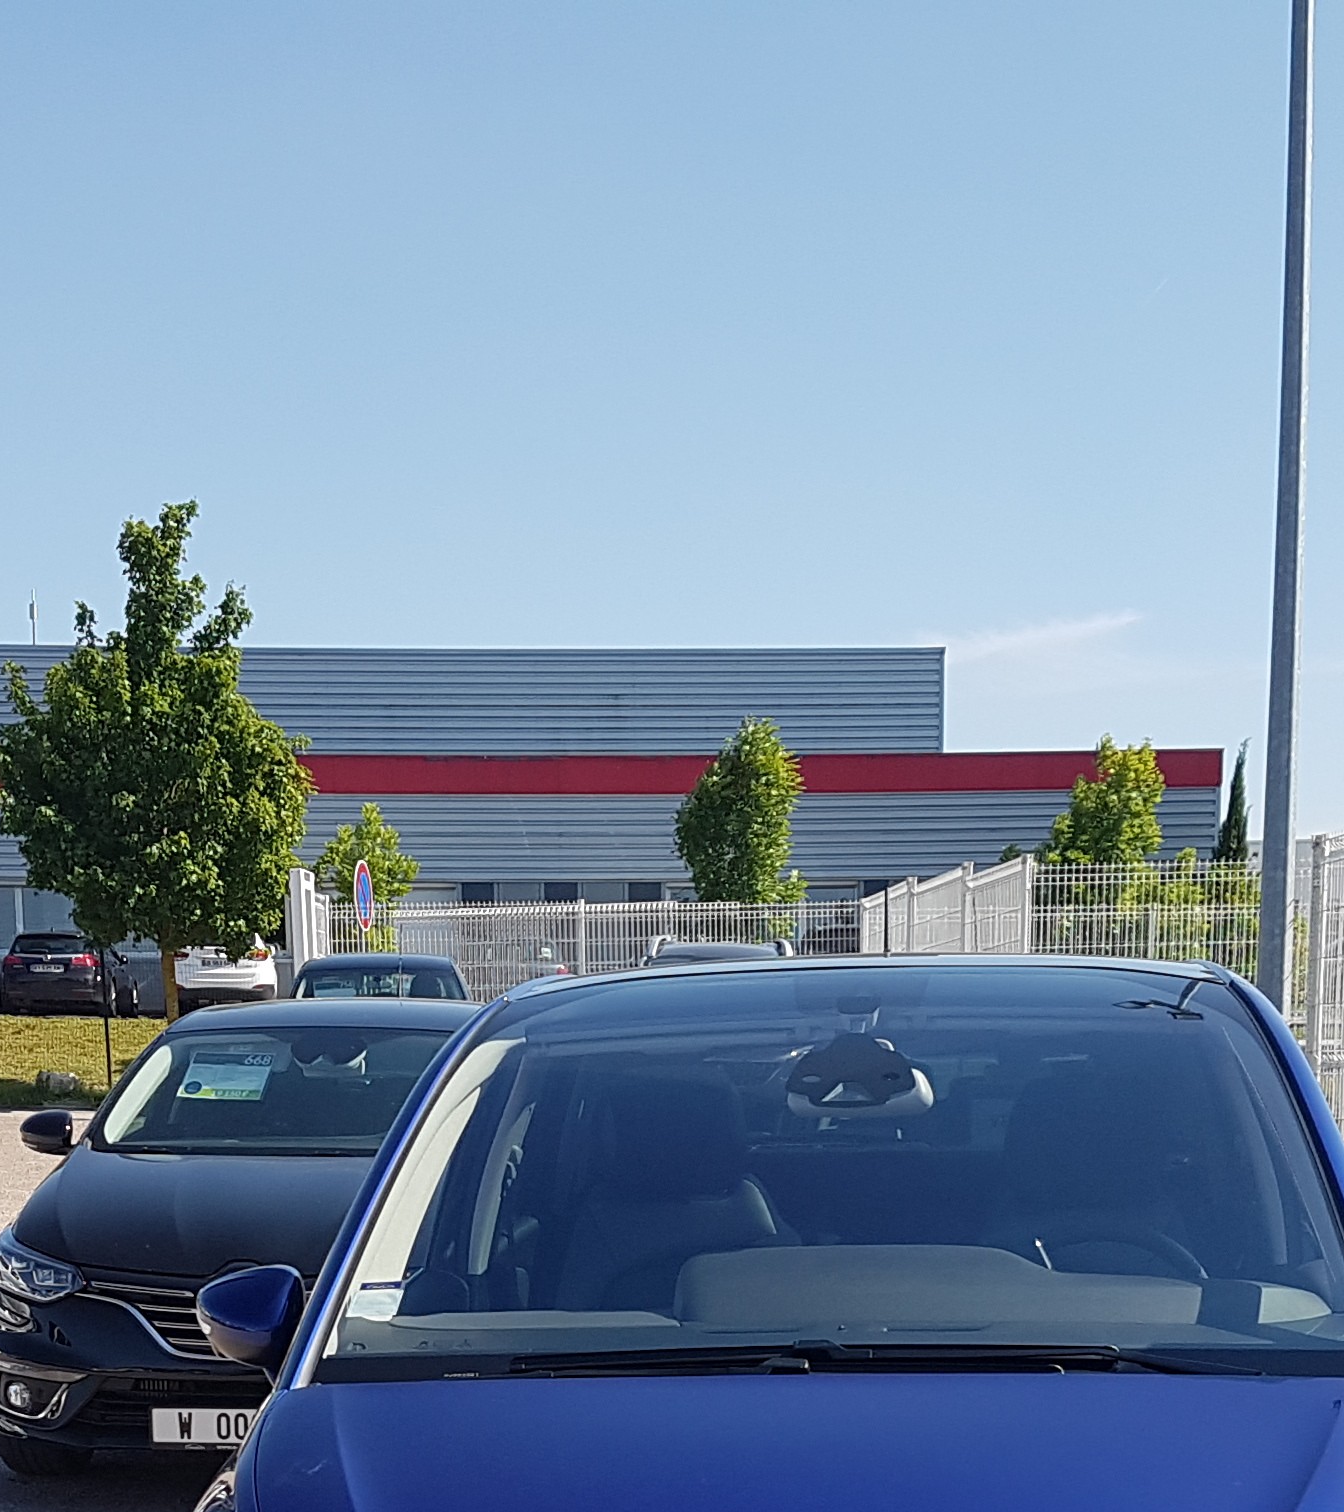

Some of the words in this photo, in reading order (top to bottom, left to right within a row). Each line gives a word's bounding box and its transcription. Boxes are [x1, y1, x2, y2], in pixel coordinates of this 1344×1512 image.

[244, 1055, 271, 1065] 668
[178, 1412, 192, 1439] W
[217, 1412, 256, 1440] 00
